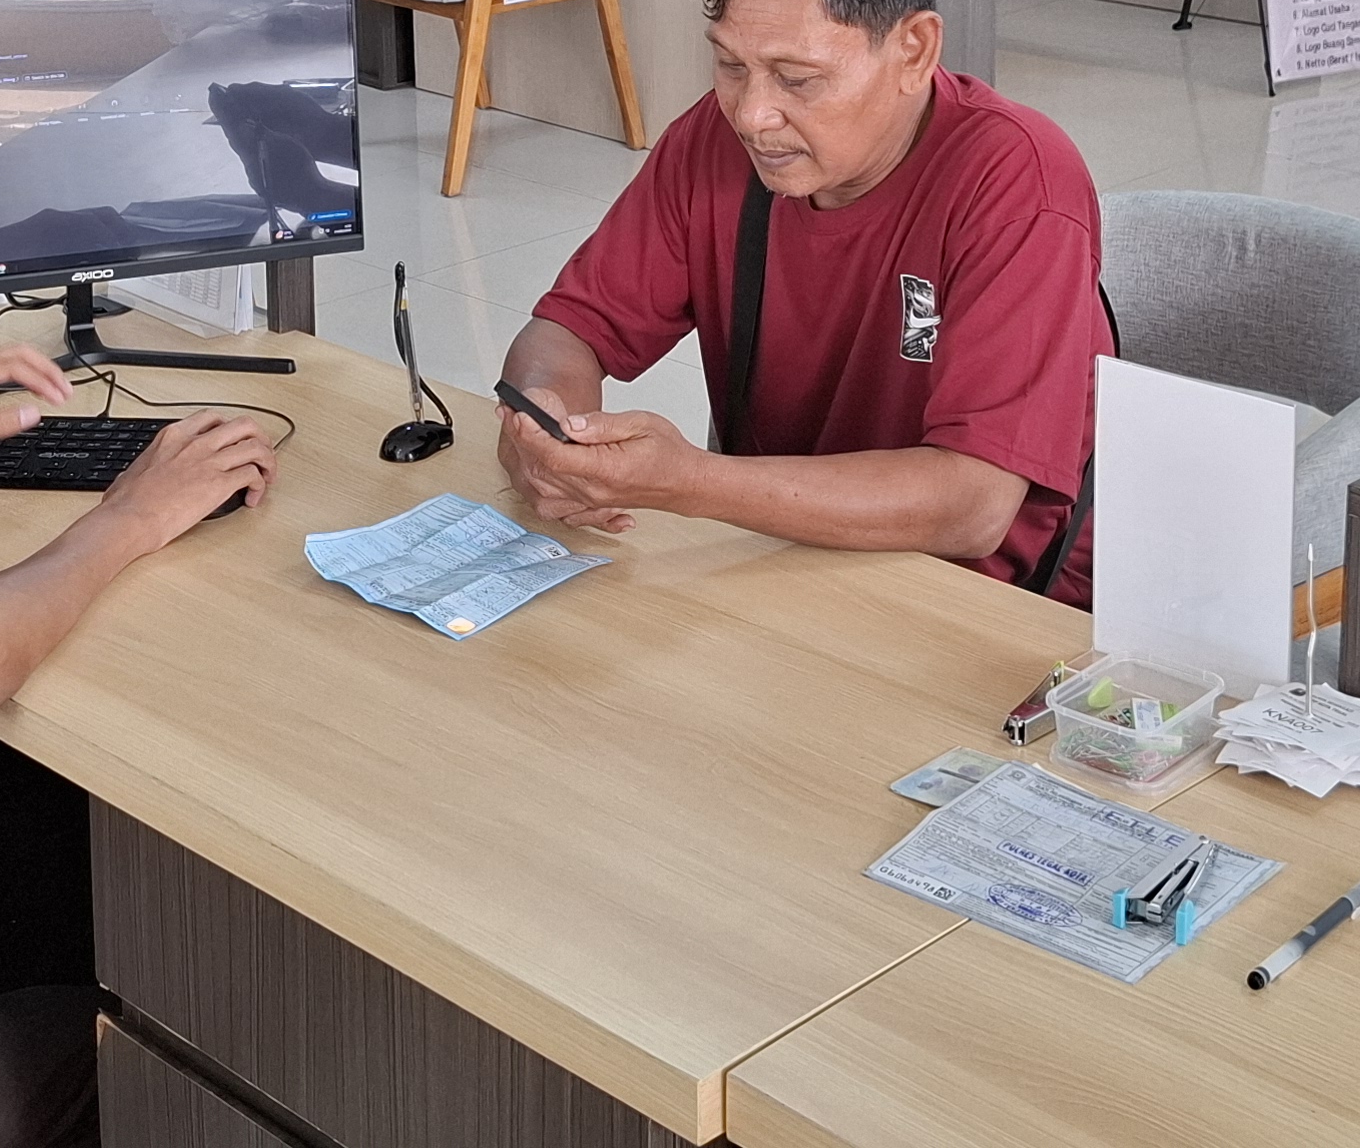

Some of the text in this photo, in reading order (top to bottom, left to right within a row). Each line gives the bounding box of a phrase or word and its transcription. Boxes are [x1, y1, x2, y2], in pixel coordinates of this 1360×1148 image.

[1302, 4, 1350, 18] Alamat Usaha
[1303, 25, 1320, 37] Logo
[1321, 21, 1336, 32] Cuci
[1305, 41, 1321, 54] Logo
[1322, 38, 1345, 50] Buang
[1305, 57, 1326, 69] Netto
[1262, 708, 1324, 734] KNA007
[1037, 856, 1063, 873] TEGAL
